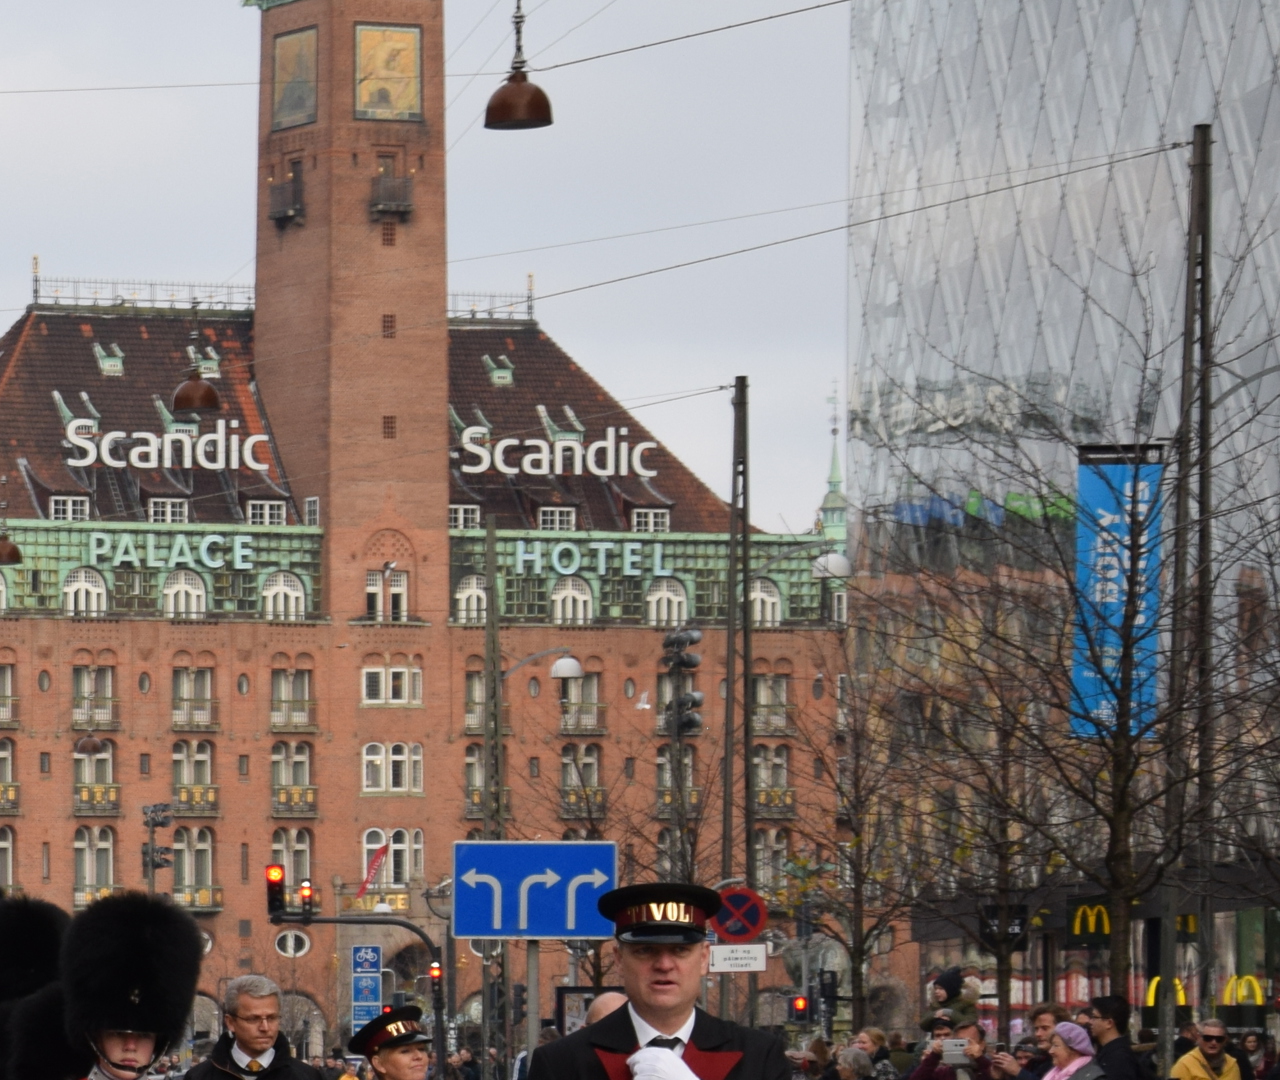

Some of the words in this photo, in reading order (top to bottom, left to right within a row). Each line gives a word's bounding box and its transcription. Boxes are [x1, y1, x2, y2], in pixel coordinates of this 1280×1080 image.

[66, 418, 269, 471] Scandic
[460, 426, 658, 477] Scandic
[89, 532, 254, 570] PALACE
[515, 539, 674, 577] HOTEL
[1094, 508, 1121, 603] BODY
